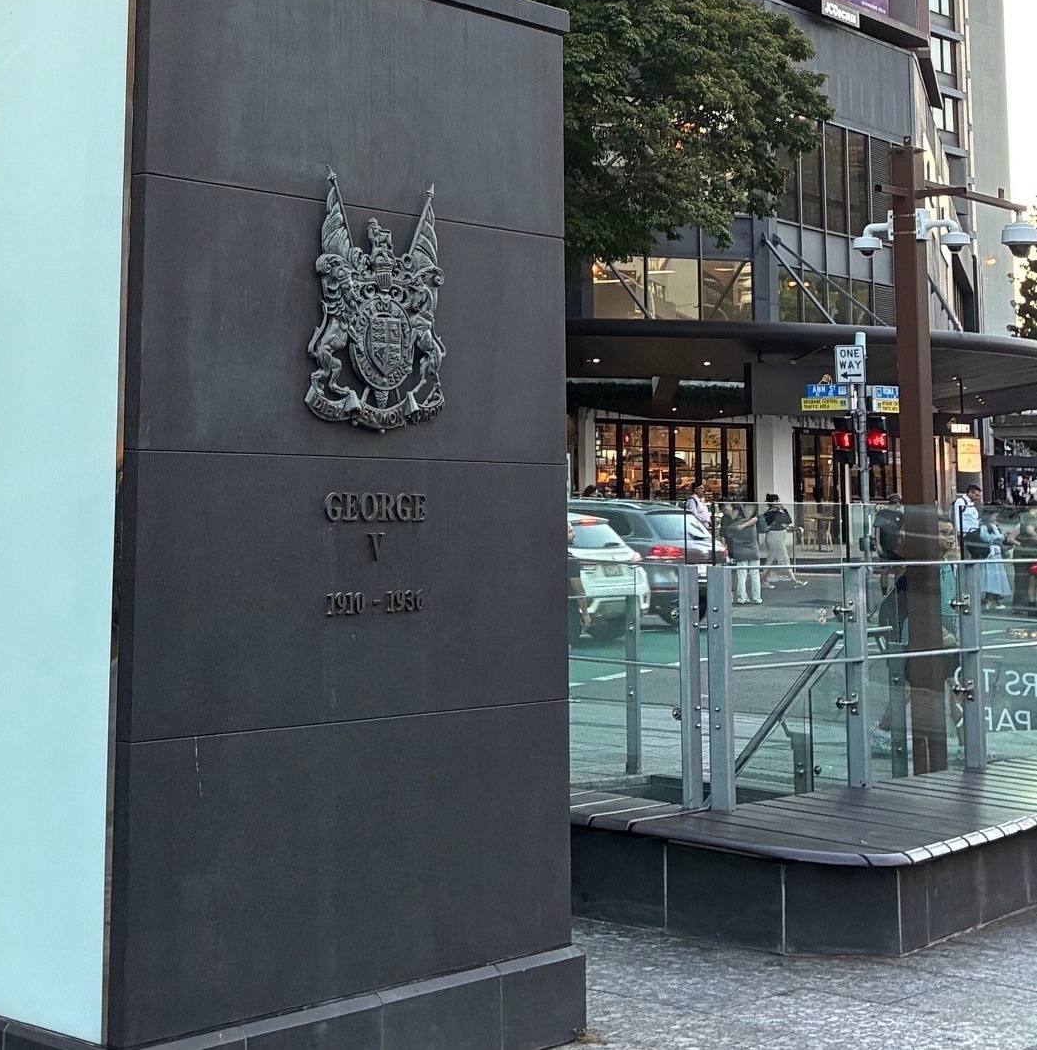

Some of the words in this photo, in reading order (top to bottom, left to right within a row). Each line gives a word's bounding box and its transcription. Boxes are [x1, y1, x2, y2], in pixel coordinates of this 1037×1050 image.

[839, 360, 861, 370] WAY
[840, 349, 860, 358] ONE
[325, 491, 426, 522] GEORGE
[367, 532, 386, 562] V
[326, 592, 363, 616] 1910
[386, 589, 424, 613] 1936
